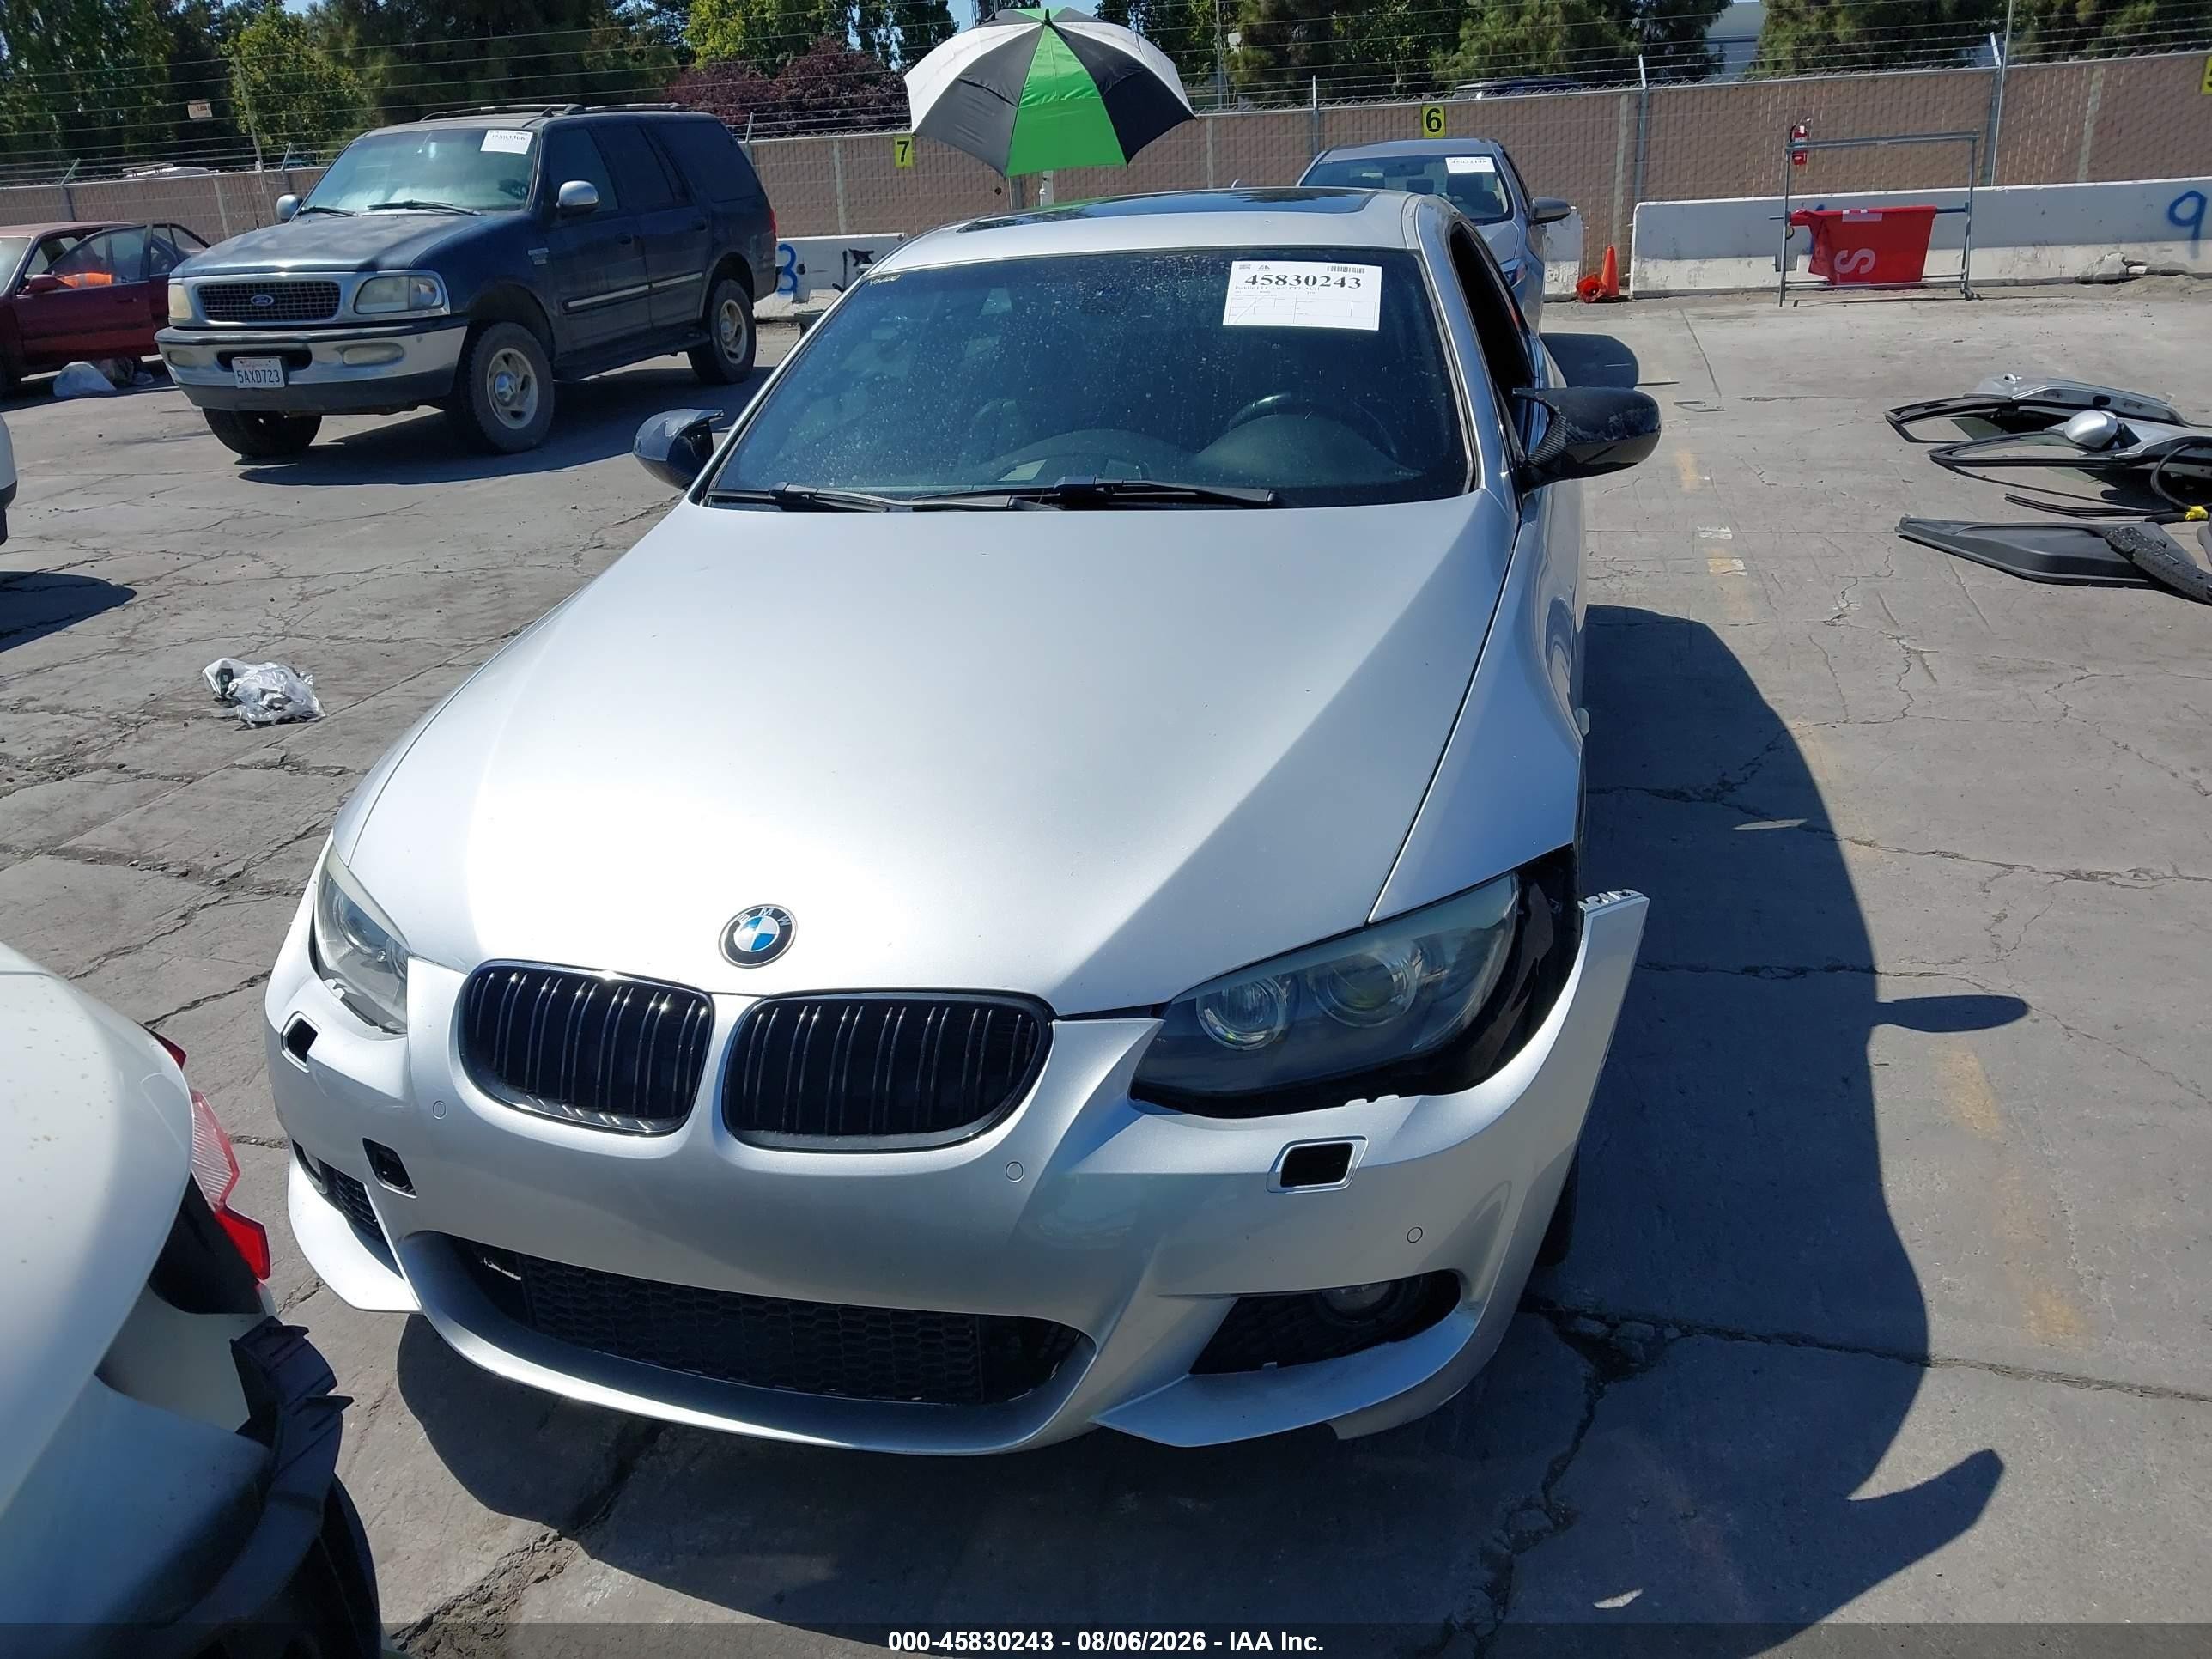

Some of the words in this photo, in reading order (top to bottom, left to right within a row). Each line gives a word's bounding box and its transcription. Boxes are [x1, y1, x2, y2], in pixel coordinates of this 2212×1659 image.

[1426, 108, 1442, 132] 6
[897, 141, 909, 162] 7
[2168, 191, 2207, 258] 9
[1244, 274, 1362, 289] 45830243
[236, 369, 281, 384] 5AXD723
